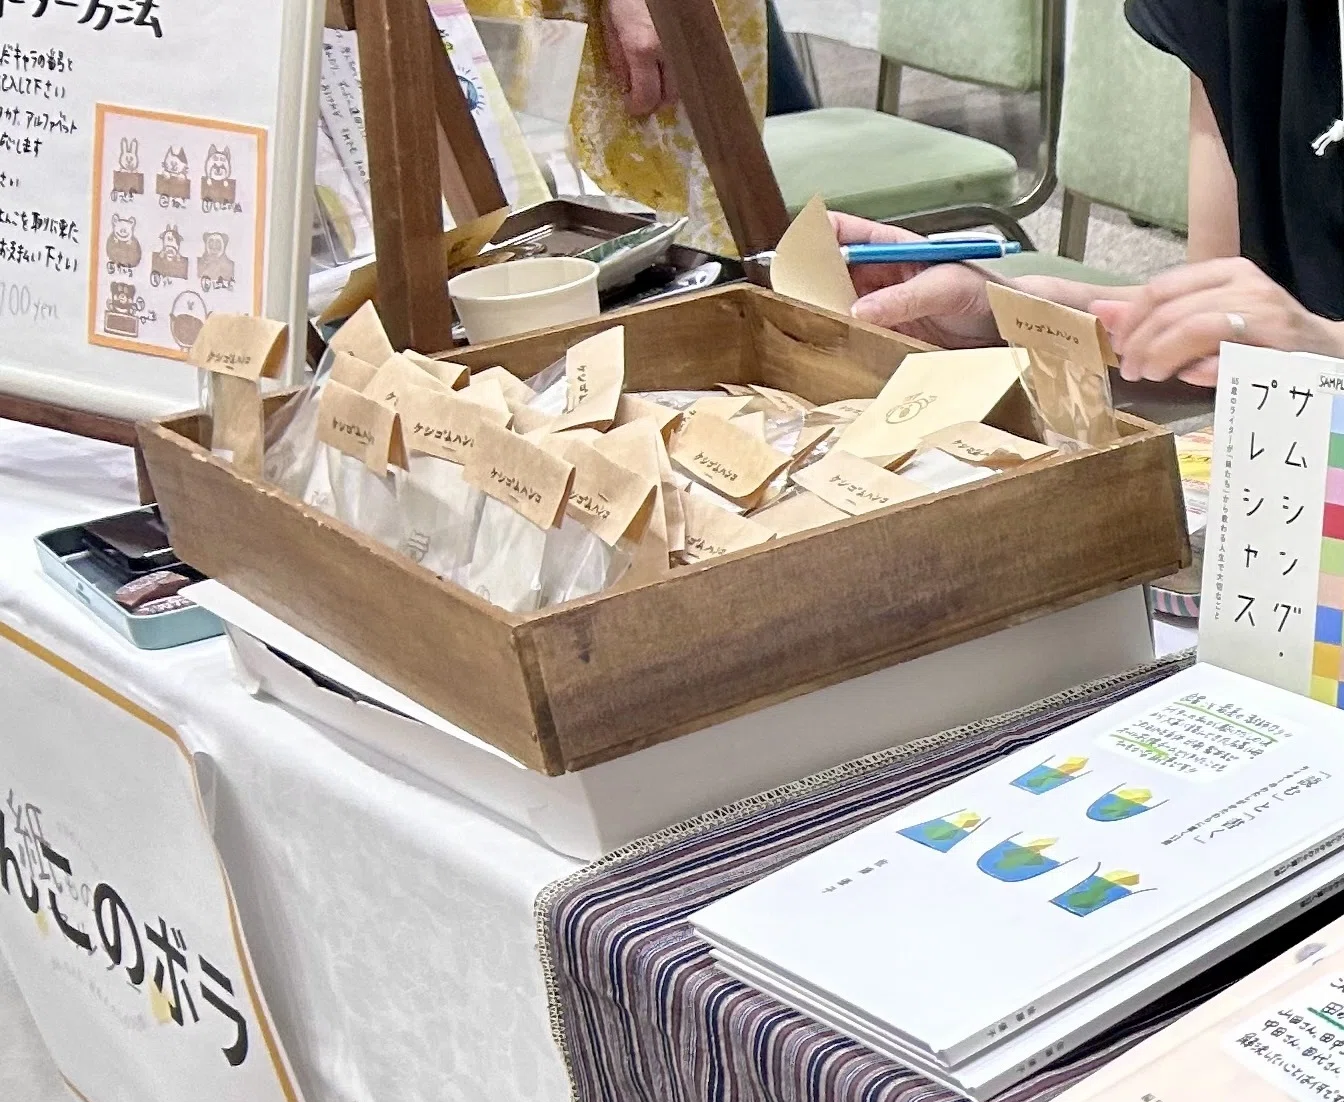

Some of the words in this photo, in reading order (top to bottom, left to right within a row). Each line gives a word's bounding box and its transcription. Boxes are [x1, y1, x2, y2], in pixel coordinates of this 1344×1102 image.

[1232, 378, 1280, 630] プレシャス
